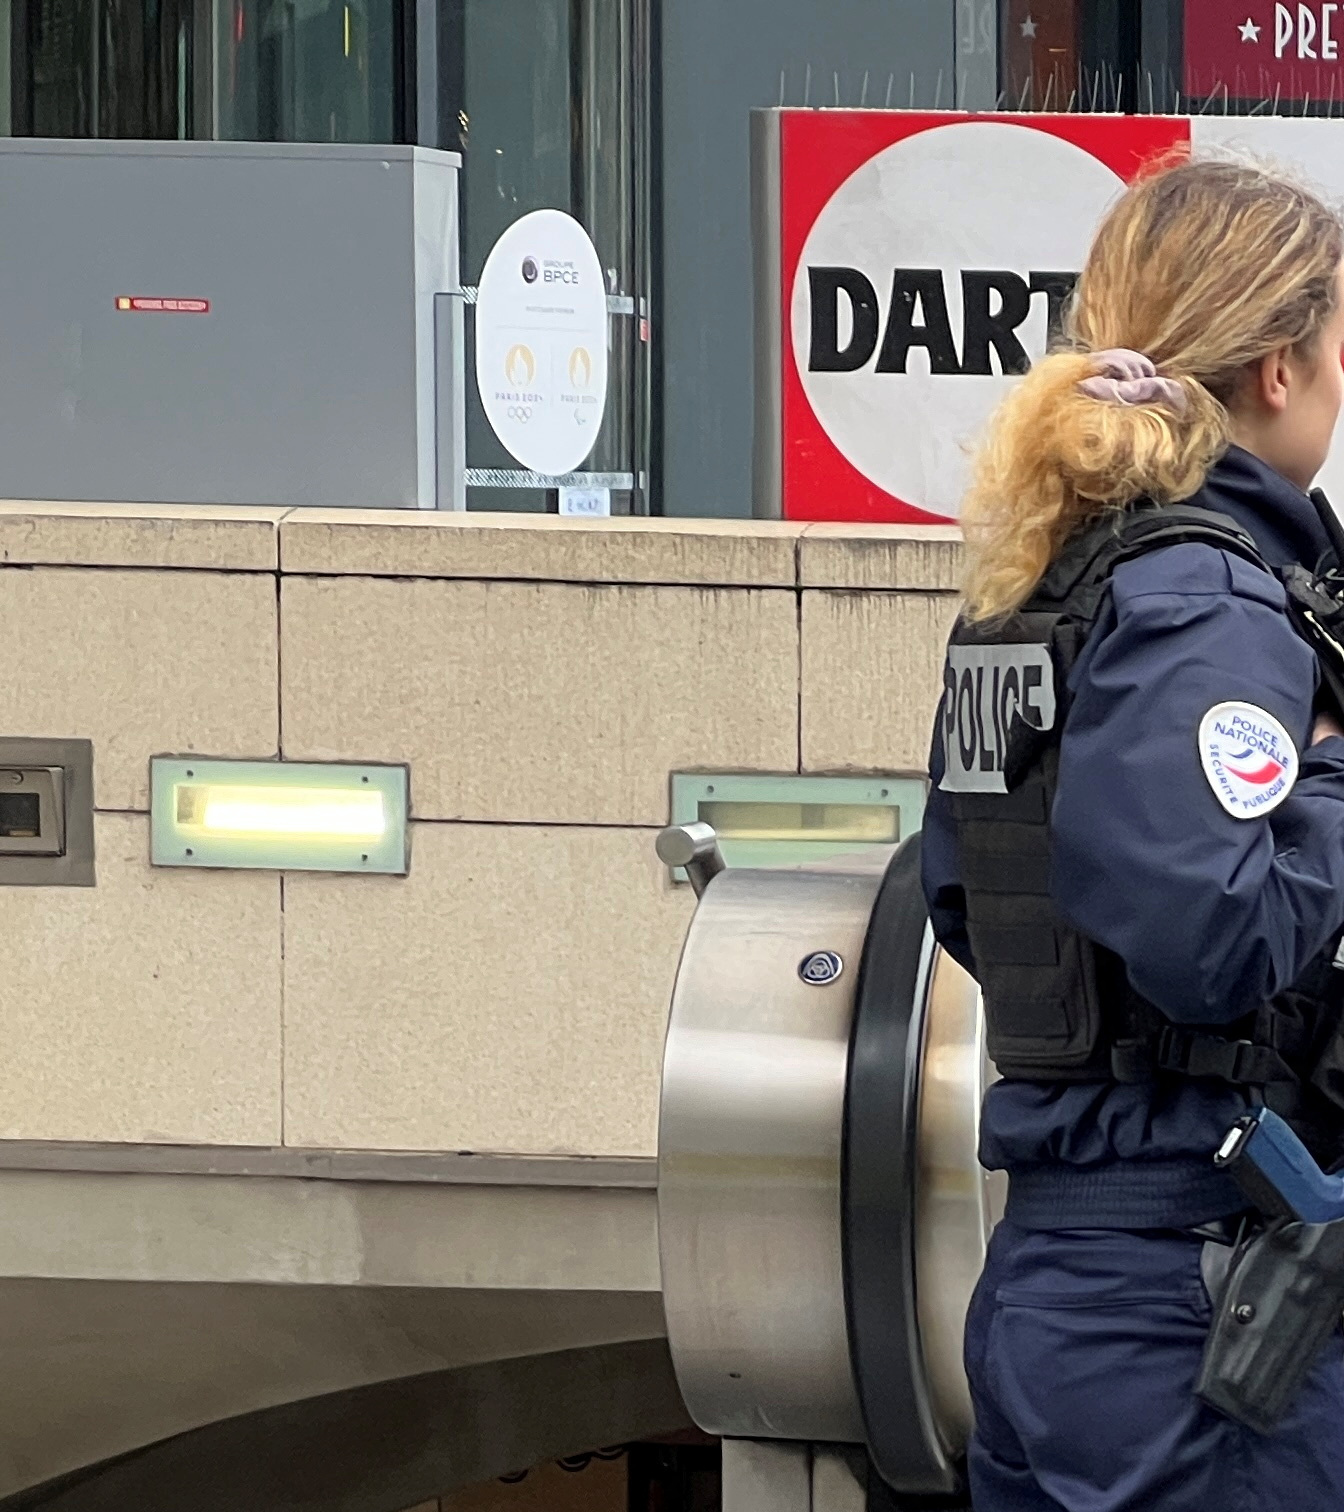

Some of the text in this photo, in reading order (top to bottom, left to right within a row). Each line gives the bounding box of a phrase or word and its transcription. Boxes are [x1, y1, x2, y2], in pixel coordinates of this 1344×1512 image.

[543, 270, 579, 284] BPCE
[807, 266, 1082, 376] DART
[1214, 721, 1289, 769] NATIONALE
[1231, 715, 1278, 748] POLICE
[1242, 777, 1286, 809] PUBLIQUE
